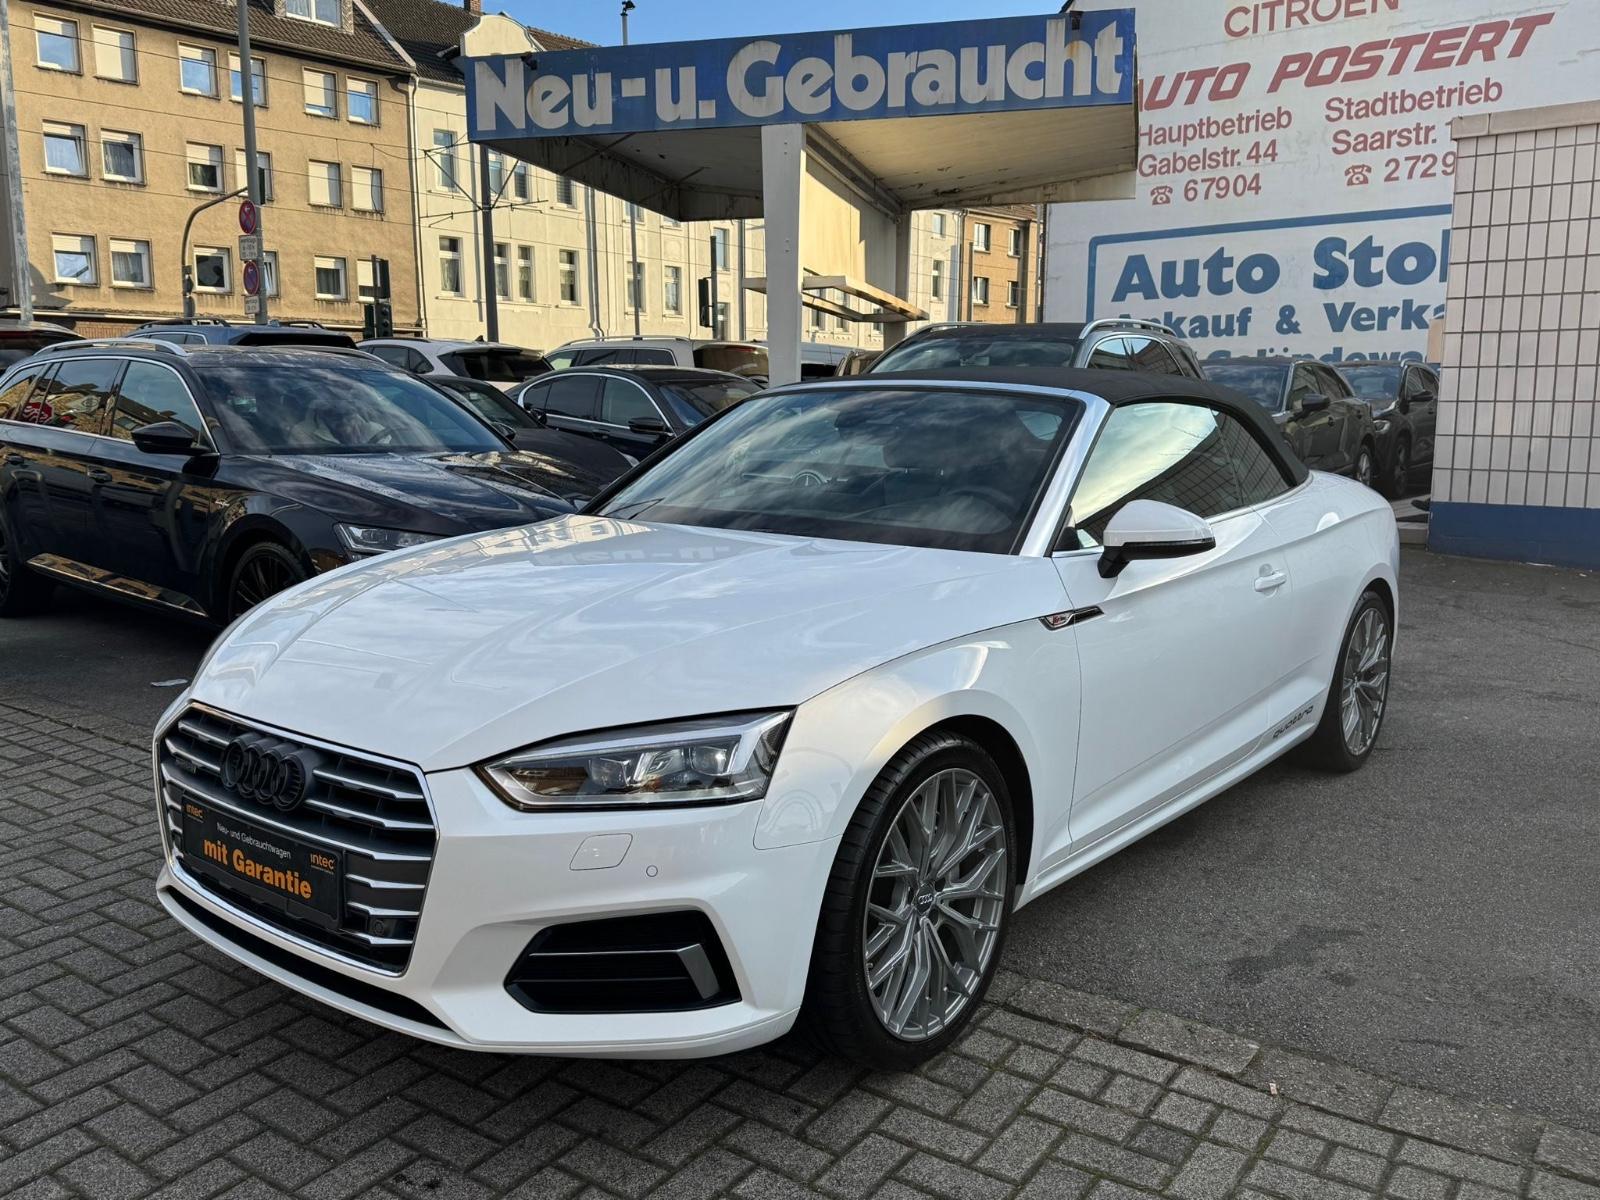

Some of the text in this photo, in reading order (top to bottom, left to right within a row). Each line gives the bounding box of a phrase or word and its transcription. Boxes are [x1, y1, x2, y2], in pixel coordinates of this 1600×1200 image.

[726, 18, 1123, 117] Gebraucht
[1138, 12, 1555, 112] UTO POSTERT
[1325, 77, 1503, 122] Stadtbetrieb
[1139, 106, 1293, 147] Hauptbetrieb
[1332, 122, 1437, 155] Saarstr.
[1138, 139, 1278, 178] Gabelstr. 44
[1184, 173, 1261, 201] 67904
[1111, 246, 1280, 302] Auto
[1276, 305, 1302, 335] &
[241, 832, 292, 861] Gebrauchtwagen
[203, 839, 312, 900] mit Garantie
